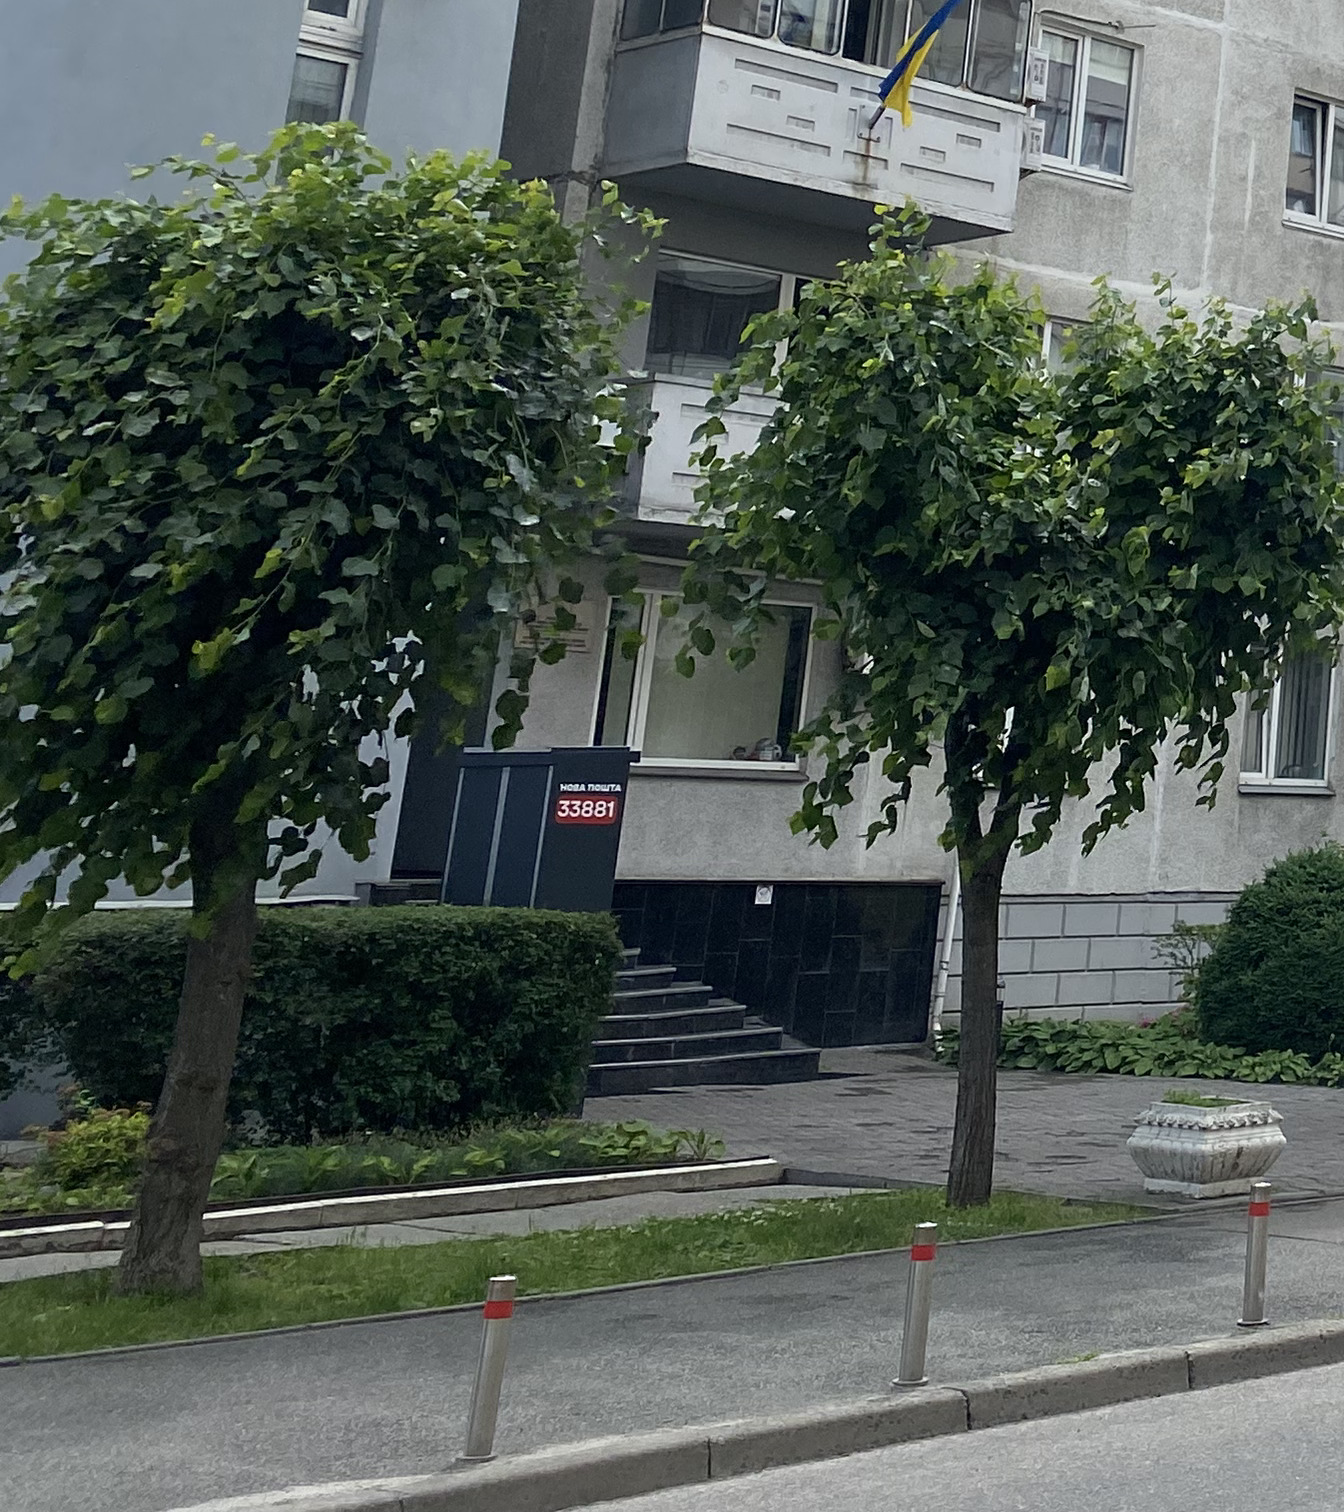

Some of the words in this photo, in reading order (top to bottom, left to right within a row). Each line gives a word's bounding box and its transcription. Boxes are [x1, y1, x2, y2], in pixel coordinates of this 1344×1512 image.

[559, 783, 586, 792] НОВА
[587, 783, 622, 792] ПОШТА
[557, 799, 615, 818] 33881
